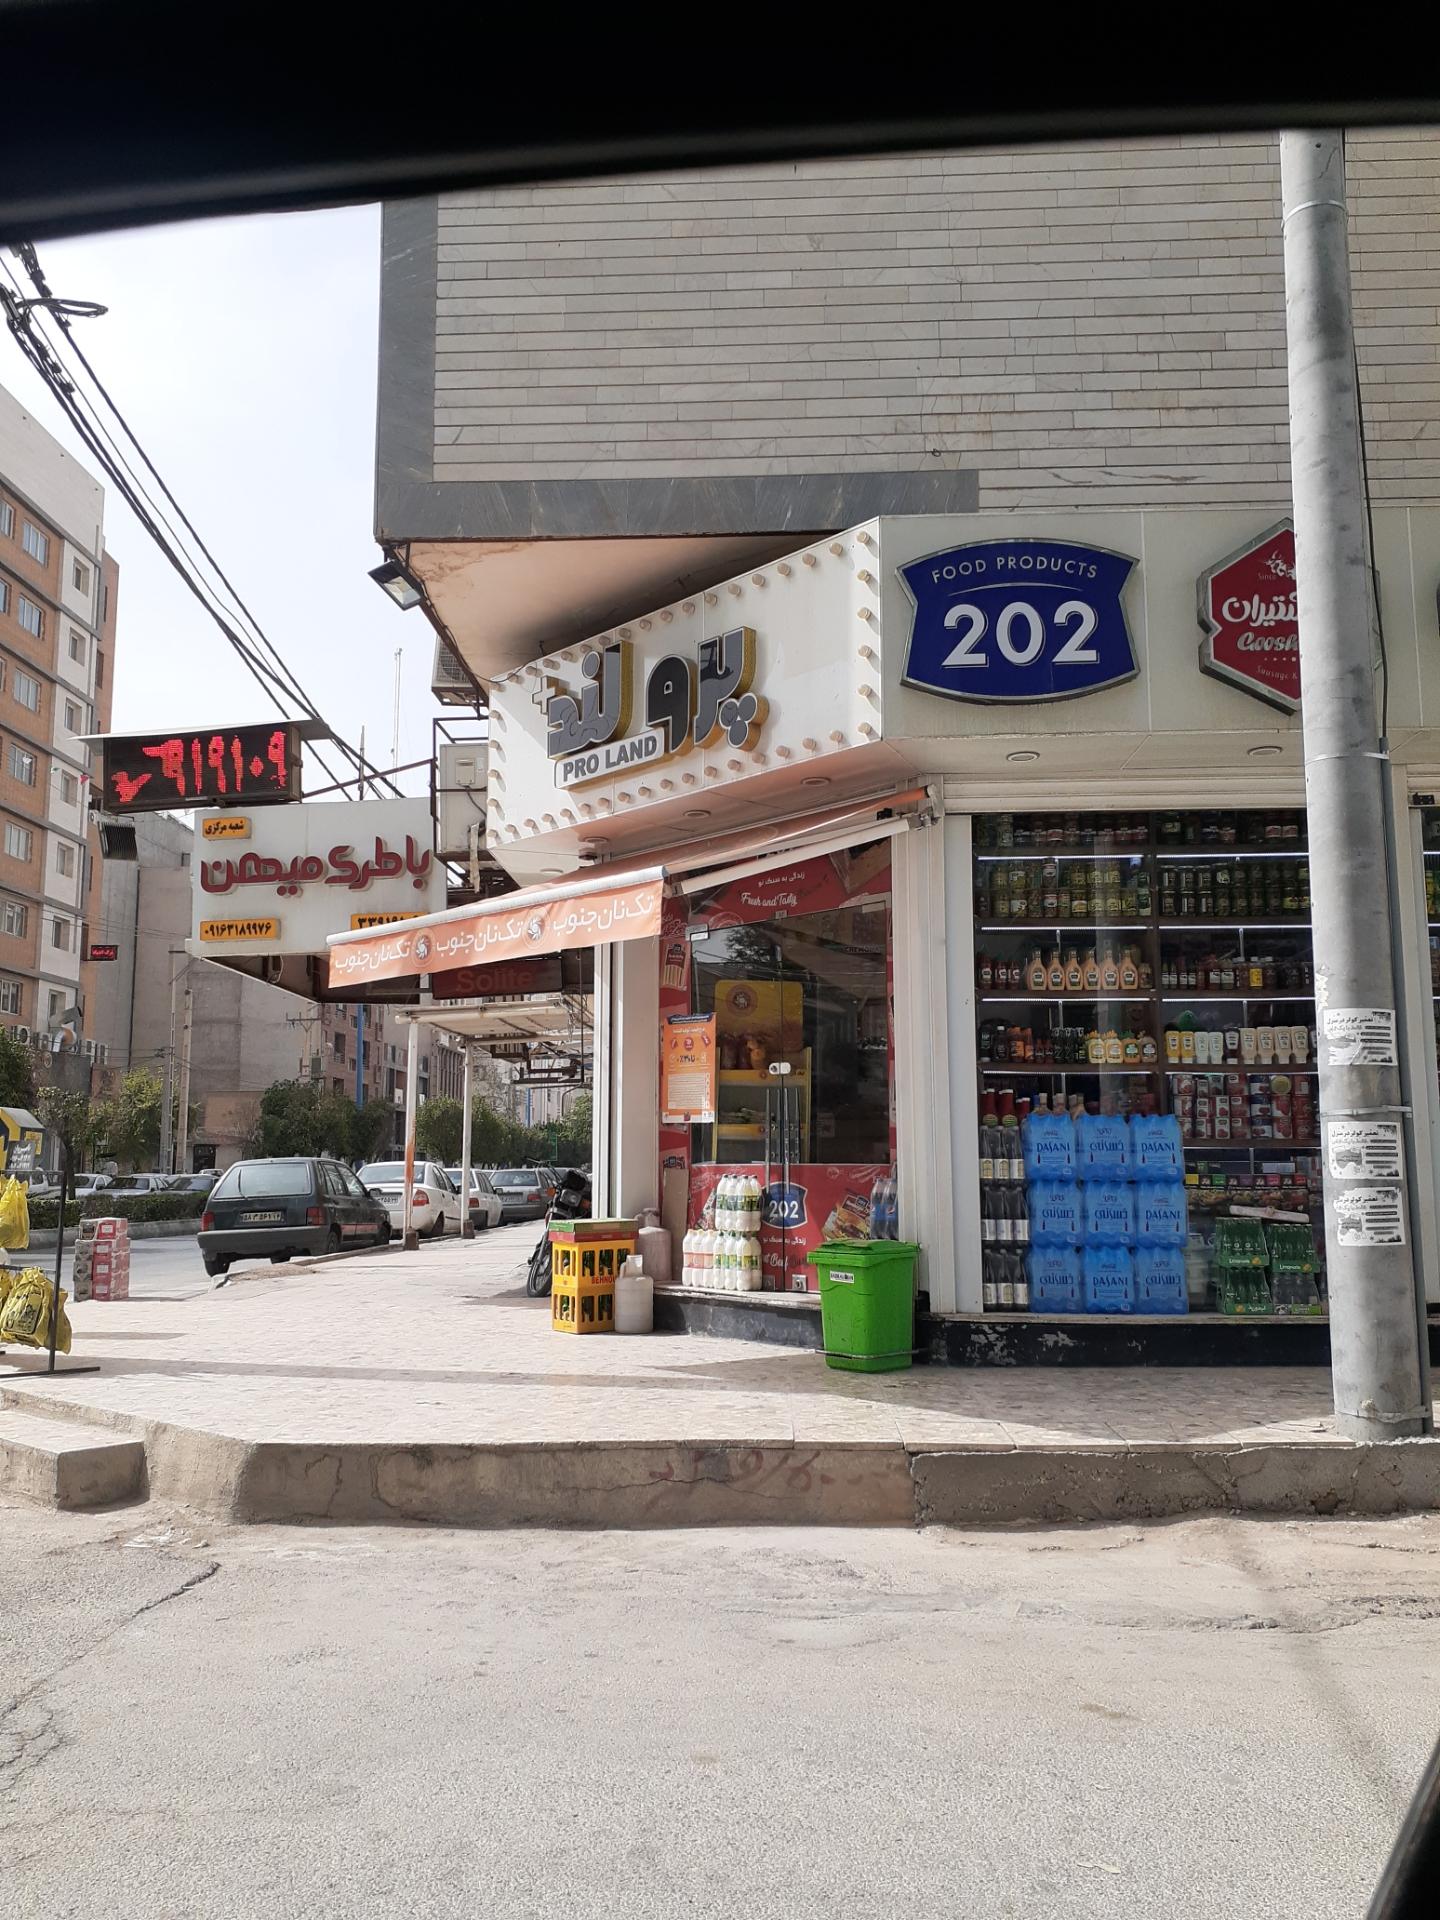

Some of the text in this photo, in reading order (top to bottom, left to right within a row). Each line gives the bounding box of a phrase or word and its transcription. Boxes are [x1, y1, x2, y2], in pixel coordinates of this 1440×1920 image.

[931, 555, 1098, 583] FOOD PRODUCTS
[941, 600, 1100, 669] 202
[562, 735, 658, 782] PRO LAND
[204, 820, 244, 835] شعبه مرکزی
[200, 834, 431, 896] باطری میهن
[762, 896, 777, 907] and
[204, 922, 272, 937] ۰۹۱۶۳۱۸۹۹۷۶
[1036, 1142, 1070, 1153] DASANI
[1141, 1142, 1175, 1153] DASANI
[769, 1200, 798, 1218] 202
[1146, 1209, 1180, 1221] DASANI
[591, 1276, 616, 1284] BEHNO
[1093, 1275, 1128, 1287] DASANI
